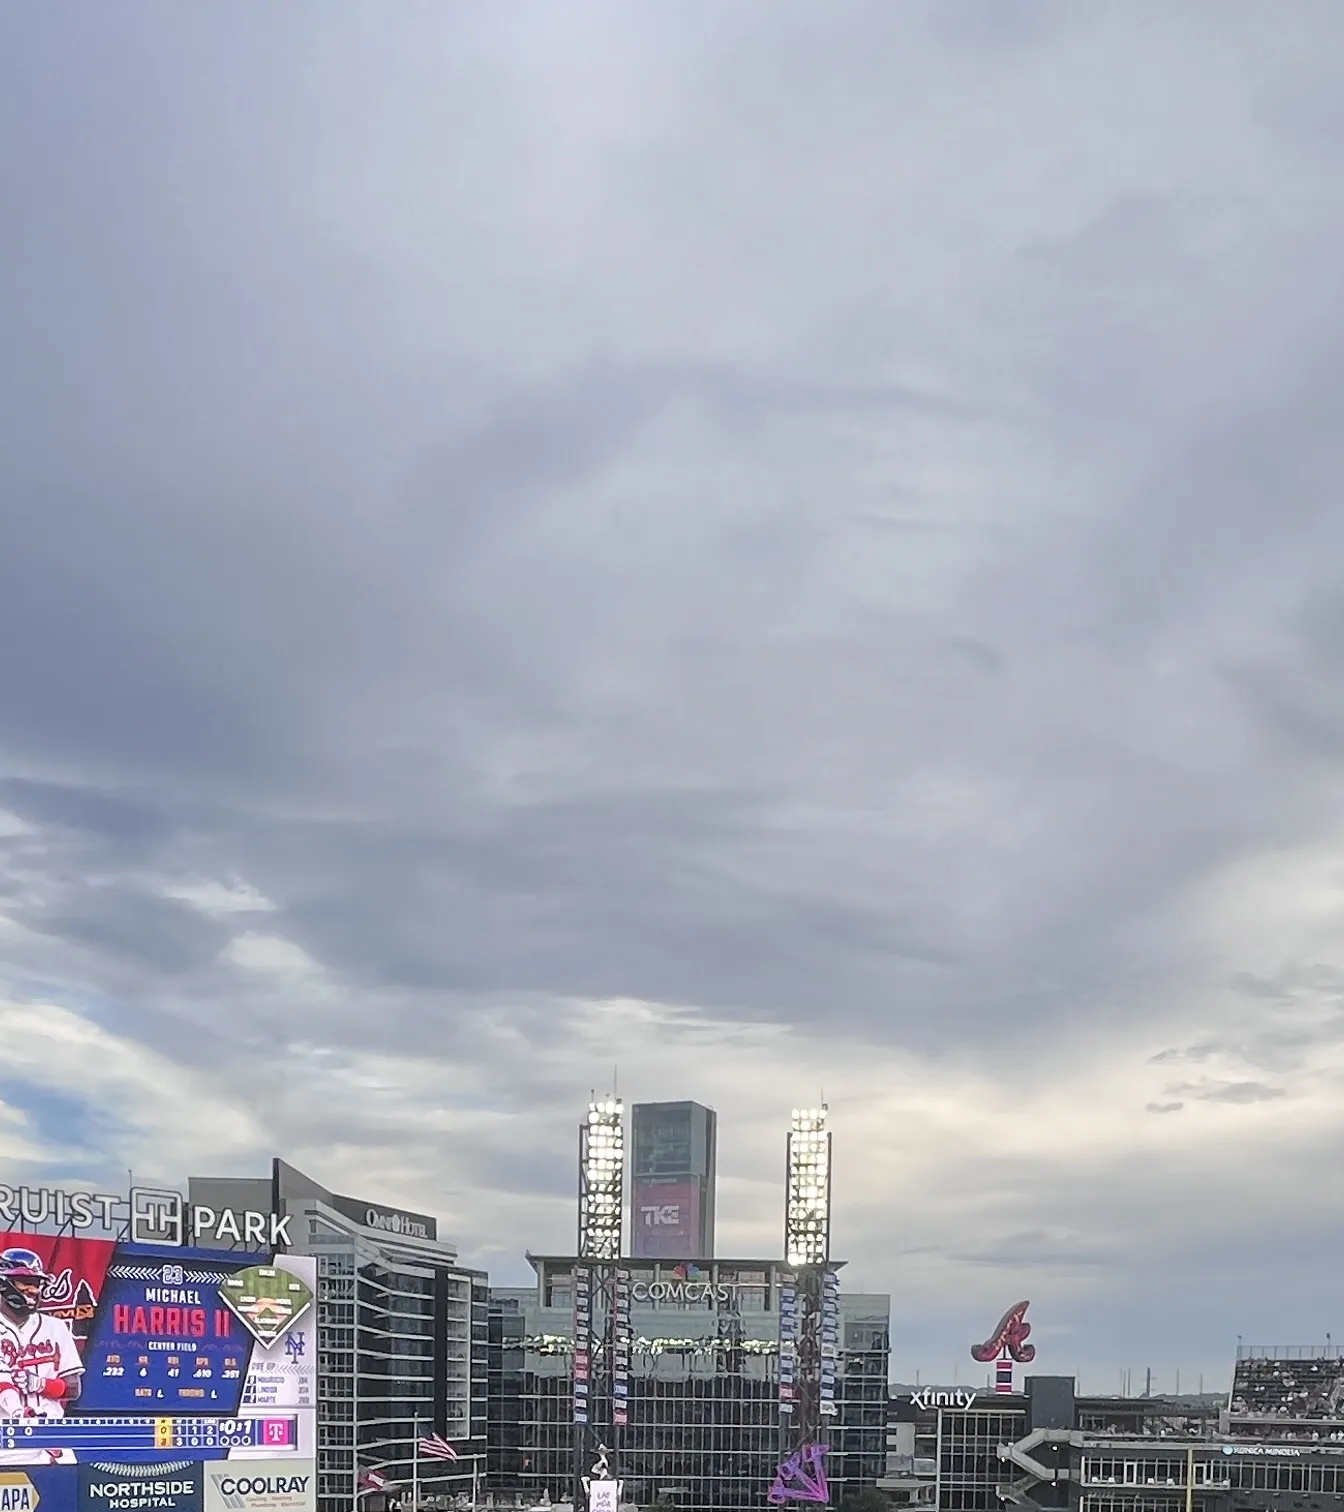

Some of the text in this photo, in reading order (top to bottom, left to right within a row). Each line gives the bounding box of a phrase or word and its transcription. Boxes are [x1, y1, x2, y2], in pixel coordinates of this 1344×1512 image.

[193, 1205, 293, 1246] PARK
[641, 1205, 680, 1227] TKE
[163, 1265, 183, 1285] 23
[146, 1288, 201, 1304] MICHAEL
[632, 1281, 738, 1303] COMCAST
[113, 1304, 231, 1338] HARRIS II
[148, 1341, 197, 1351] CENTER FIELD
[139, 1368, 147, 1377] 6
[910, 1387, 977, 1410] xfinity
[89, 1480, 194, 1498] NORTHSIDE
[220, 1475, 310, 1496] COOLRAY
[108, 1497, 176, 1509] HOSPITAL
